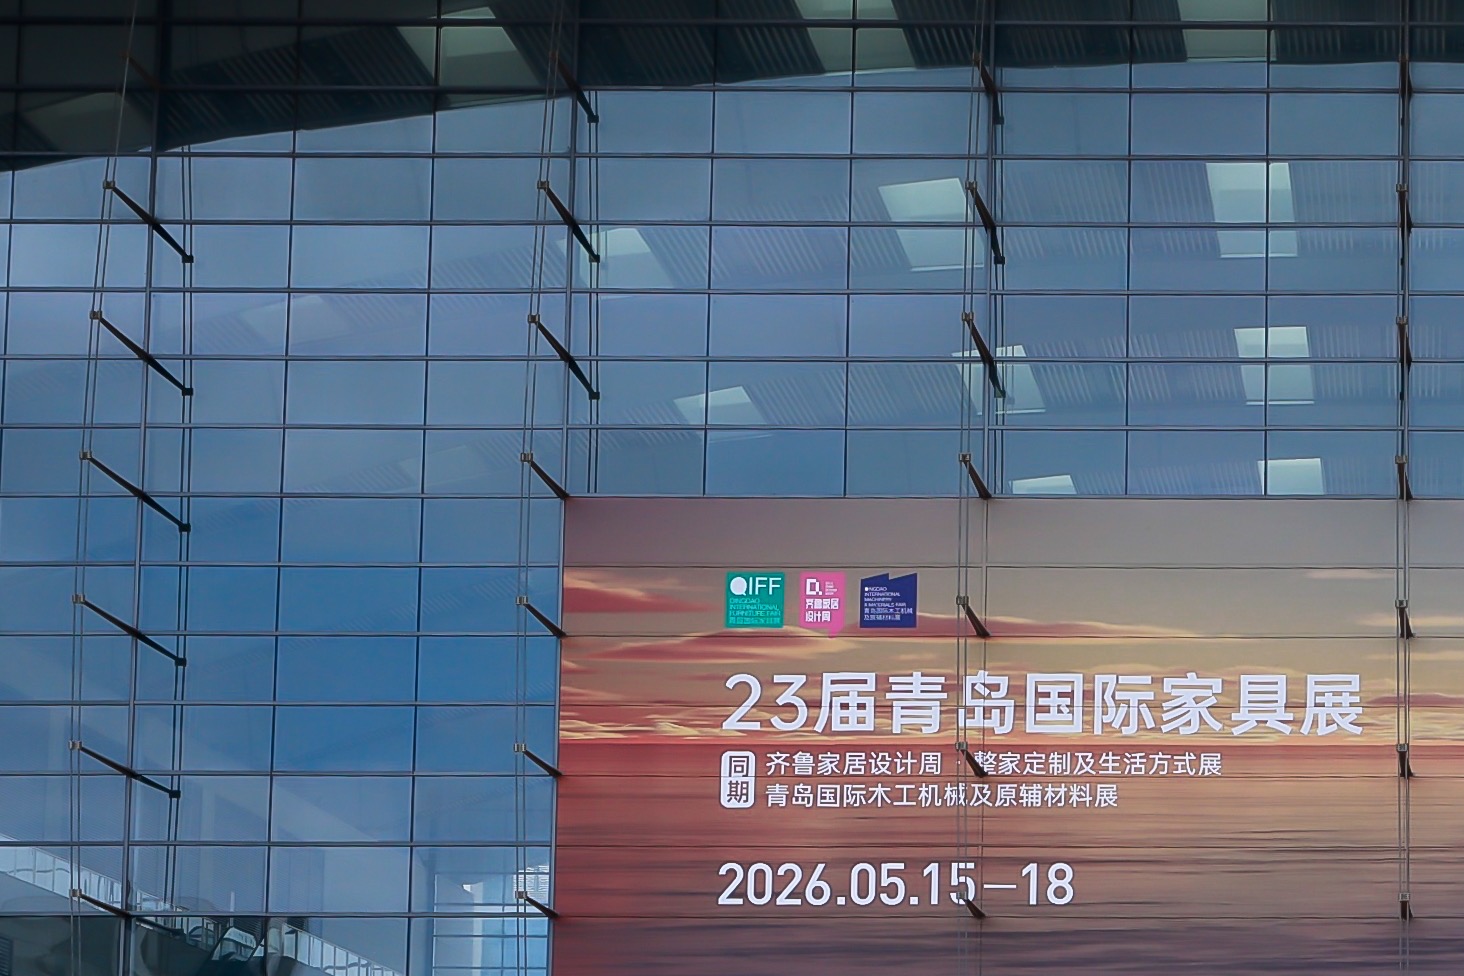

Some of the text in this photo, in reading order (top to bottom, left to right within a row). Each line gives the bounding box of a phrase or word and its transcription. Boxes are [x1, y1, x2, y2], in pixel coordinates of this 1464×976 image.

[730, 576, 782, 596] QIFF
[721, 670, 1365, 736] 23届青岛国际家具展
[765, 783, 1119, 809] 青岛国际木工机械及原辅材料展
